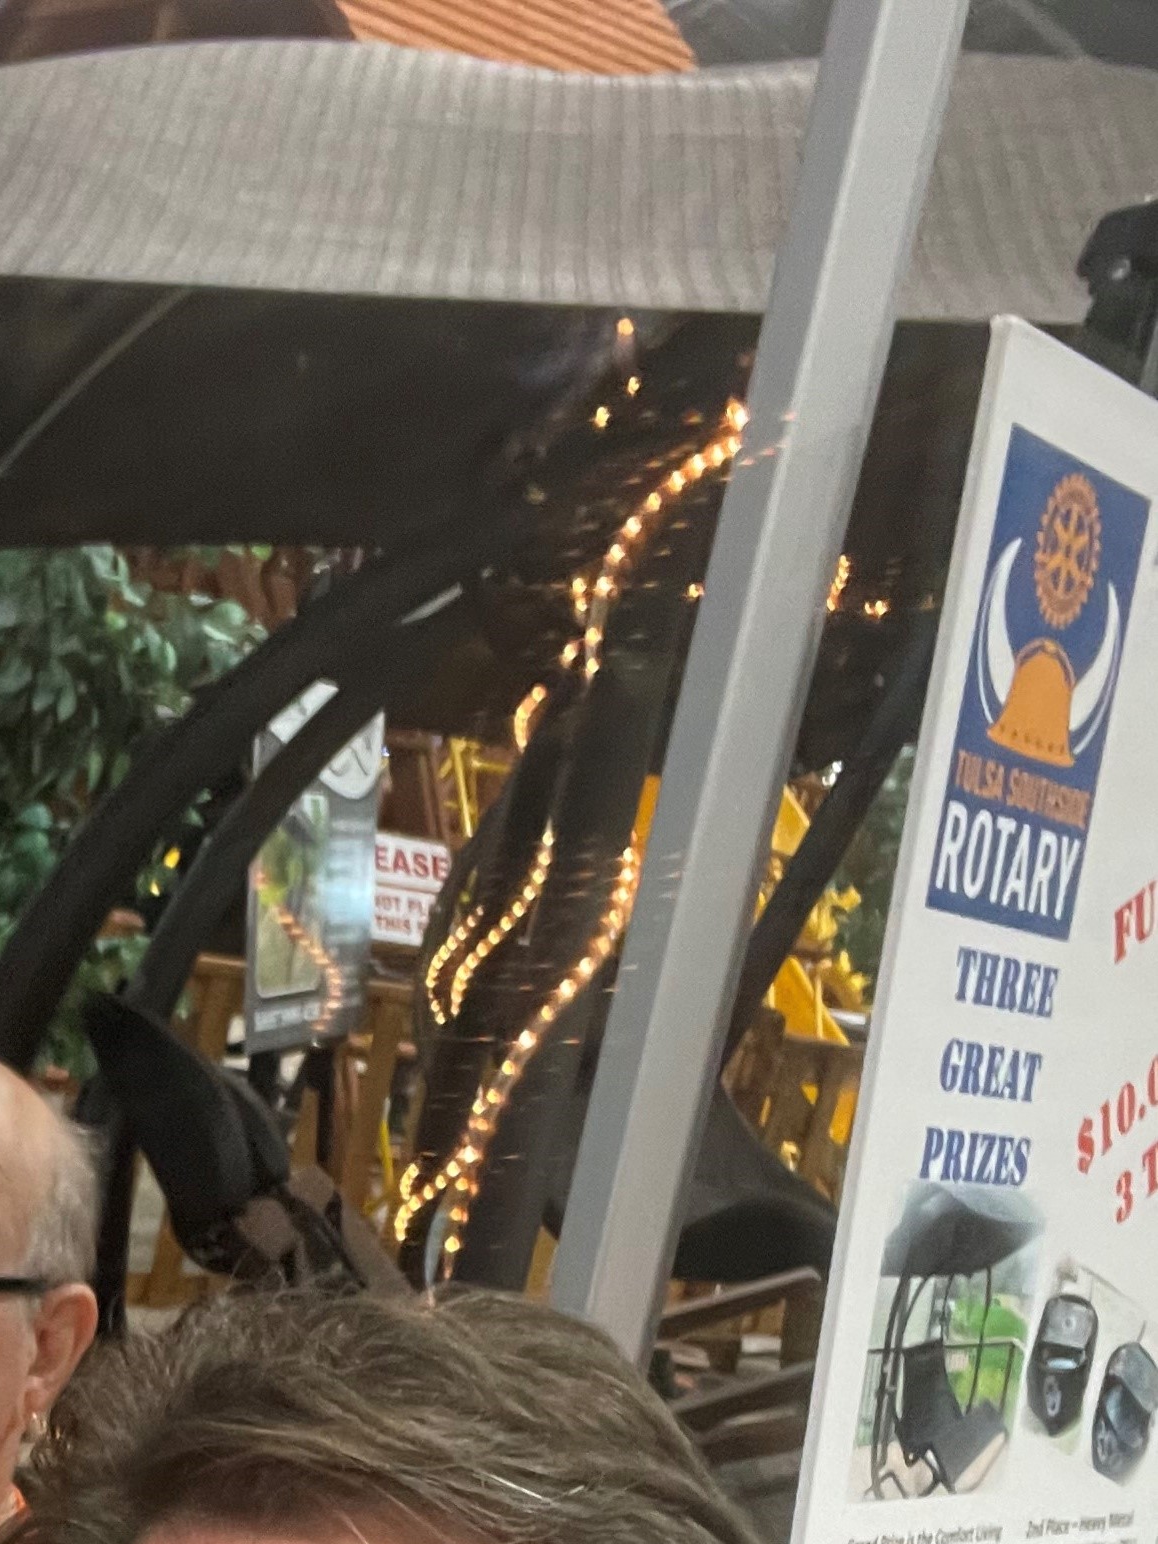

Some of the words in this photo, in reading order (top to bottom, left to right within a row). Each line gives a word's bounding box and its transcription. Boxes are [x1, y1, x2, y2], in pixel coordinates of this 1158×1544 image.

[935, 800, 1082, 921] ROTARY
[955, 945, 1059, 1019] THREE
[939, 1037, 1043, 1103] GREAT
[919, 1126, 1032, 1187] PRIZES
[1115, 1170, 1134, 1224] 3
